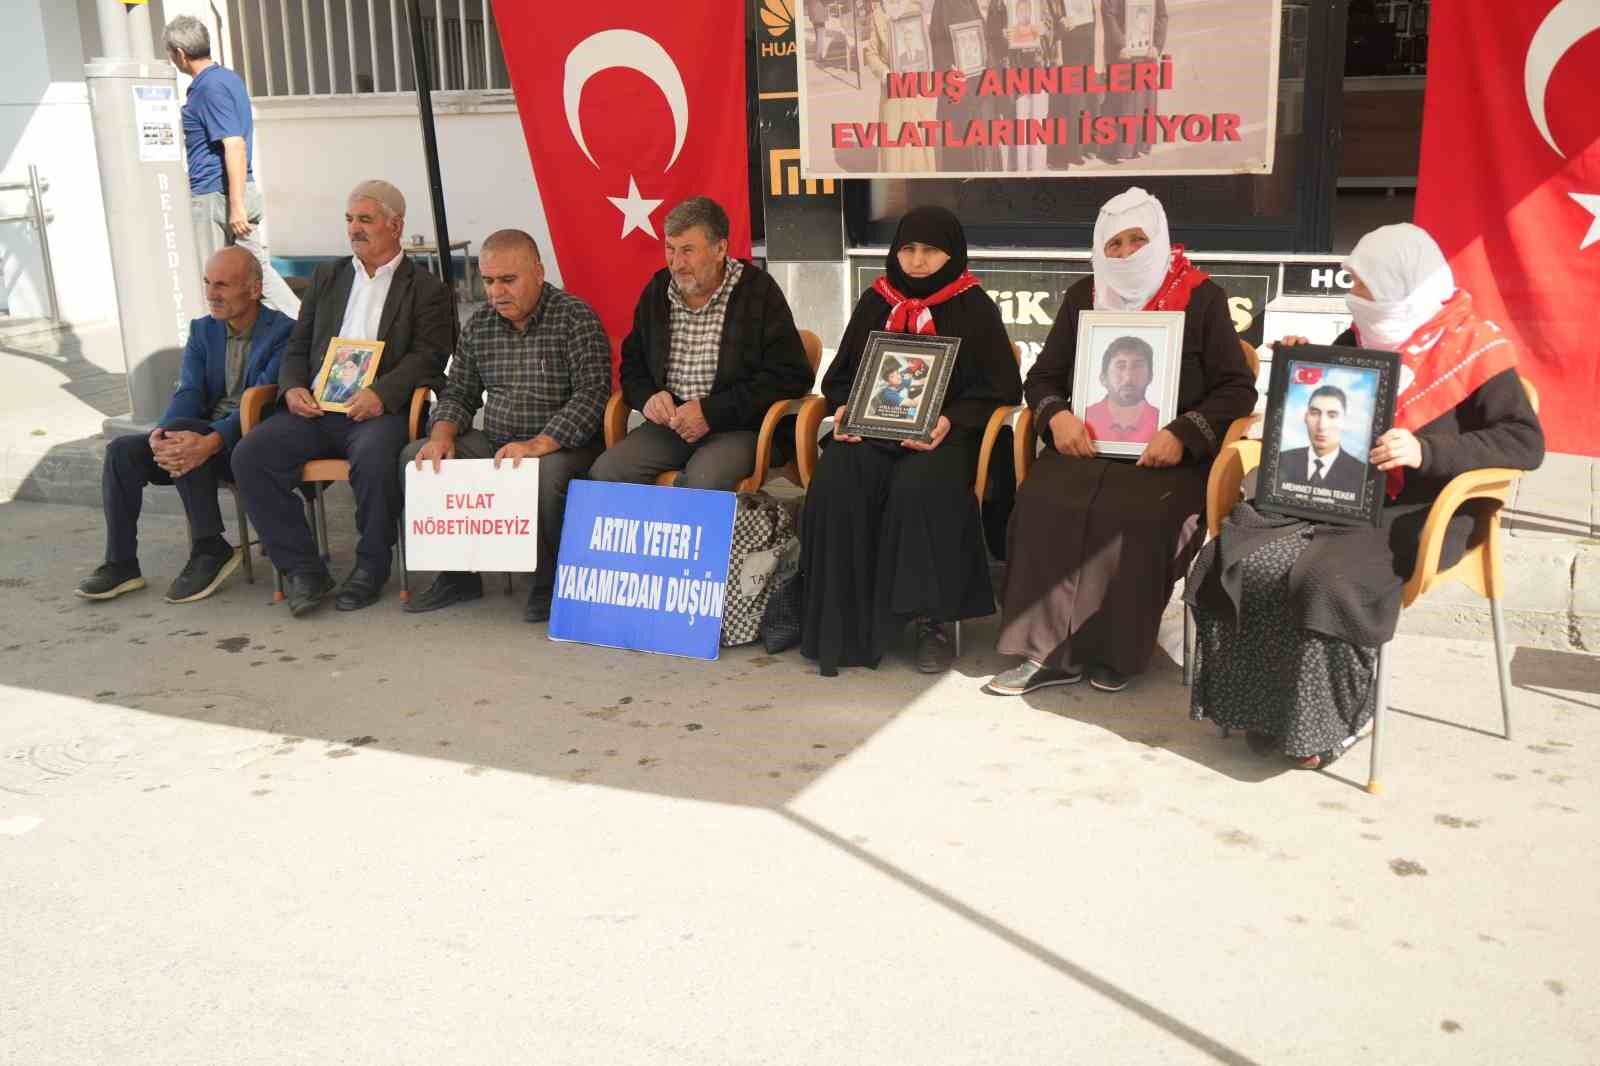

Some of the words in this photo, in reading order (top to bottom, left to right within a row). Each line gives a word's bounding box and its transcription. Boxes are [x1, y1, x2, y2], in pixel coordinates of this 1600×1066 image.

[886, 69, 969, 103] MUŞ
[979, 55, 1173, 95] ANNELERİ
[832, 116, 1067, 148] EVLATLARINI
[1078, 108, 1242, 145] İSTİYOR
[446, 493, 495, 510] EVLAT
[412, 515, 530, 535] NÖBETİNDEYİZ
[589, 516, 640, 555] ARTIK
[643, 520, 691, 560] YETER
[557, 564, 663, 610] YAKAMIZDAN
[664, 567, 725, 626] DÜŞÜN
